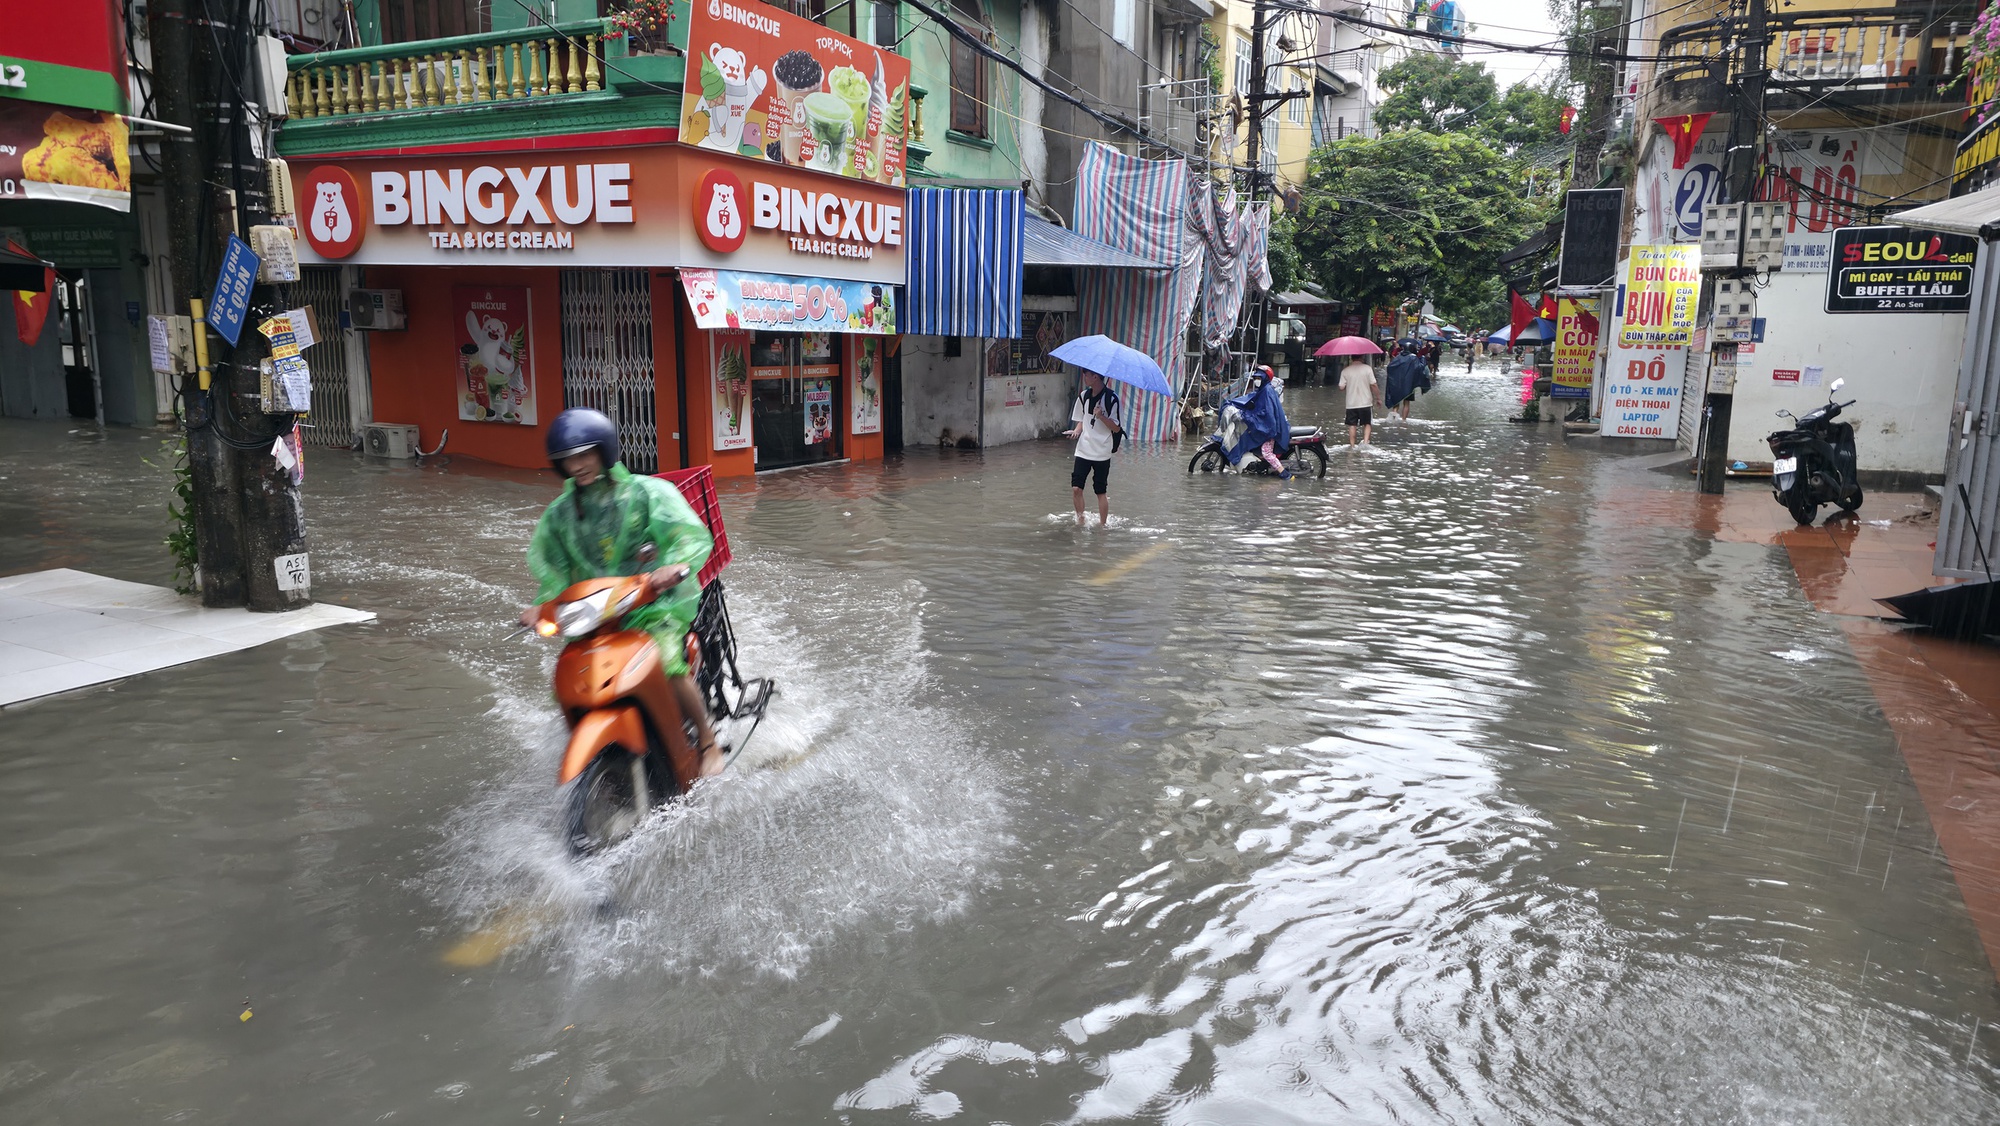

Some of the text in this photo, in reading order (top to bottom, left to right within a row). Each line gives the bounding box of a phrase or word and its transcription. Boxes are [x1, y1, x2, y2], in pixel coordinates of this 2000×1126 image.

[723, 3, 780, 37] BINGXUE
[816, 37, 853, 59] TOP PICK
[801, 146, 814, 156] 25k
[371, 163, 634, 226] BINGXUE
[753, 181, 902, 246] BINGXUE
[428, 231, 462, 249] TEA
[477, 231, 506, 249] ICE
[508, 231, 573, 249] CREAM
[790, 237, 812, 252] TEA
[821, 241, 837, 255] ICE
[838, 243, 873, 259] CREAM
[1949, 252, 1974, 263] deli
[1635, 264, 1665, 281] BÚN
[1850, 271, 1866, 283] MÌ
[1870, 273, 1893, 282] CAY
[1935, 270, 1962, 281] THÁI
[212, 242, 241, 325] PHỐ AO SEN
[1856, 285, 1916, 296] BUFFET
[226, 265, 251, 324] NGÕ 3
[741, 281, 848, 321] BINGXUE 50%
[471, 302, 507, 310] BINGXUE
[1626, 284, 1665, 326] BÚN
[1877, 300, 1892, 308] 22
[1626, 331, 1644, 340] BÚN
[1646, 331, 1667, 342] THẬP
[1627, 354, 1666, 381] ĐỒ
[806, 392, 830, 401] MULBERRY
[1610, 384, 1617, 394] Ô
[1620, 385, 1632, 394] TÔ
[1641, 387, 1653, 395] XE
[1656, 386, 1679, 396] MÁY
[1616, 398, 1670, 411] ĐIỆN THOẠI
[1622, 413, 1660, 422] LAPTOP
[1617, 424, 1662, 437] CÁC LOẠI
